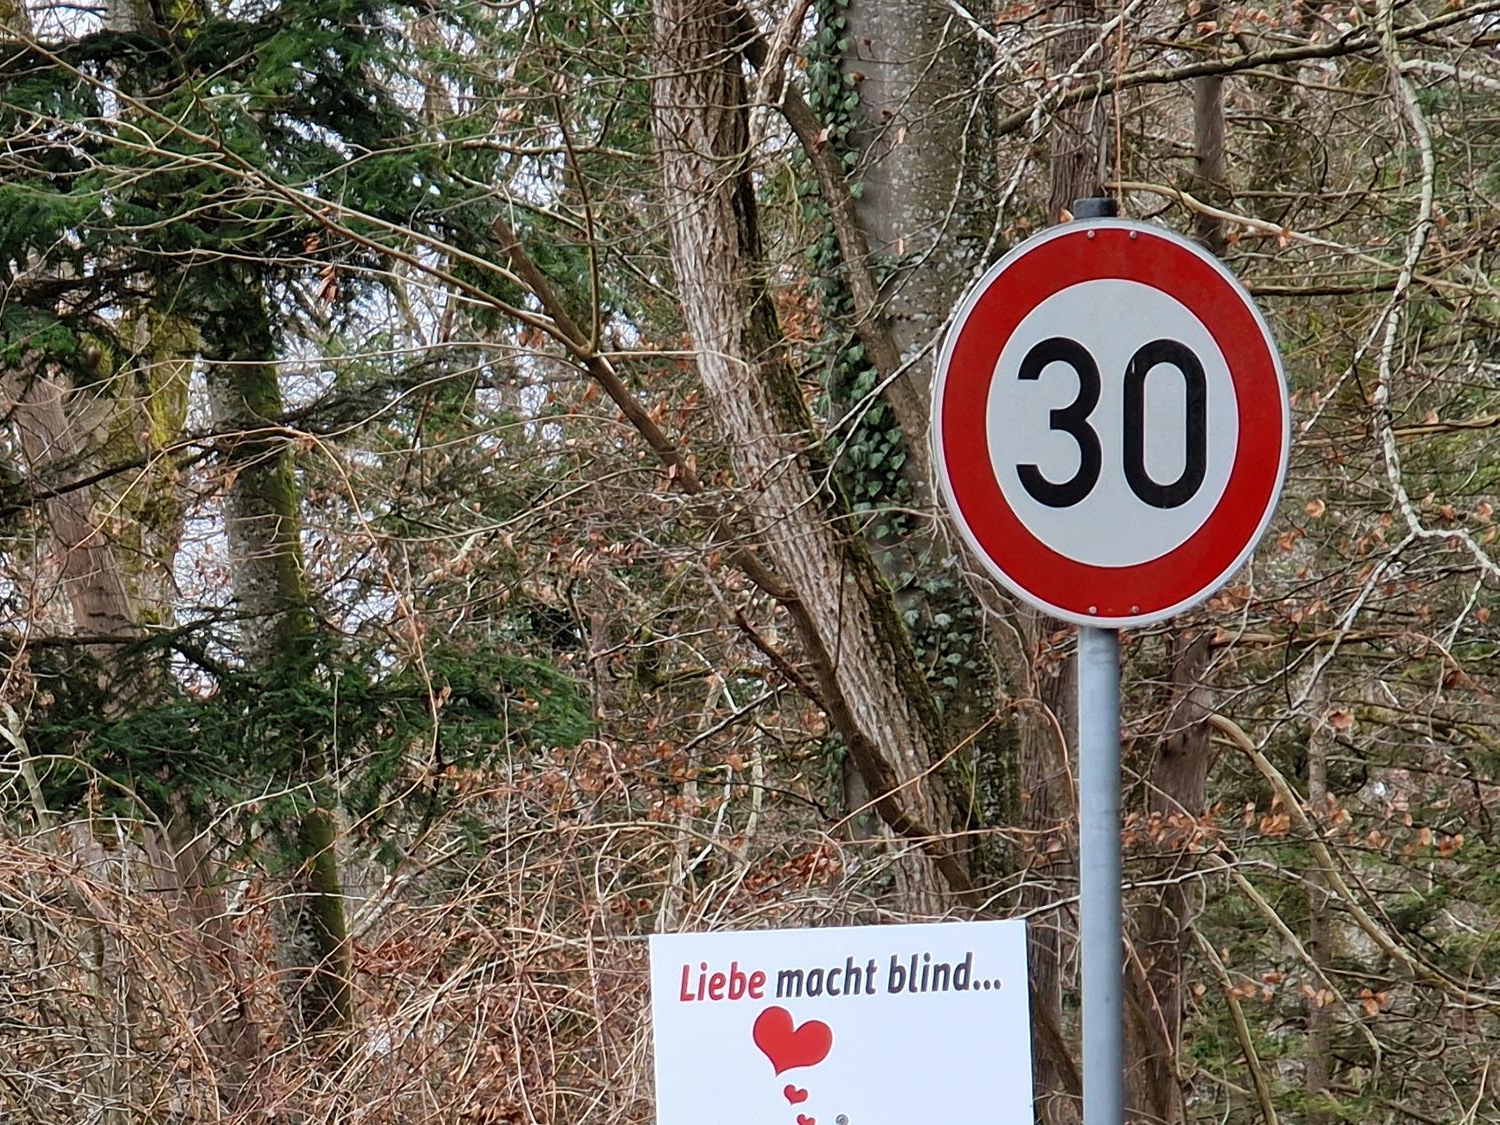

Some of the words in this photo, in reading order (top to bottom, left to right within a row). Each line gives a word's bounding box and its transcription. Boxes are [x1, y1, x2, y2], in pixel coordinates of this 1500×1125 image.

[1016, 336, 1207, 509] 30
[679, 961, 766, 1002] Liebe
[776, 956, 877, 998] macht
[887, 950, 1002, 994] blind...
